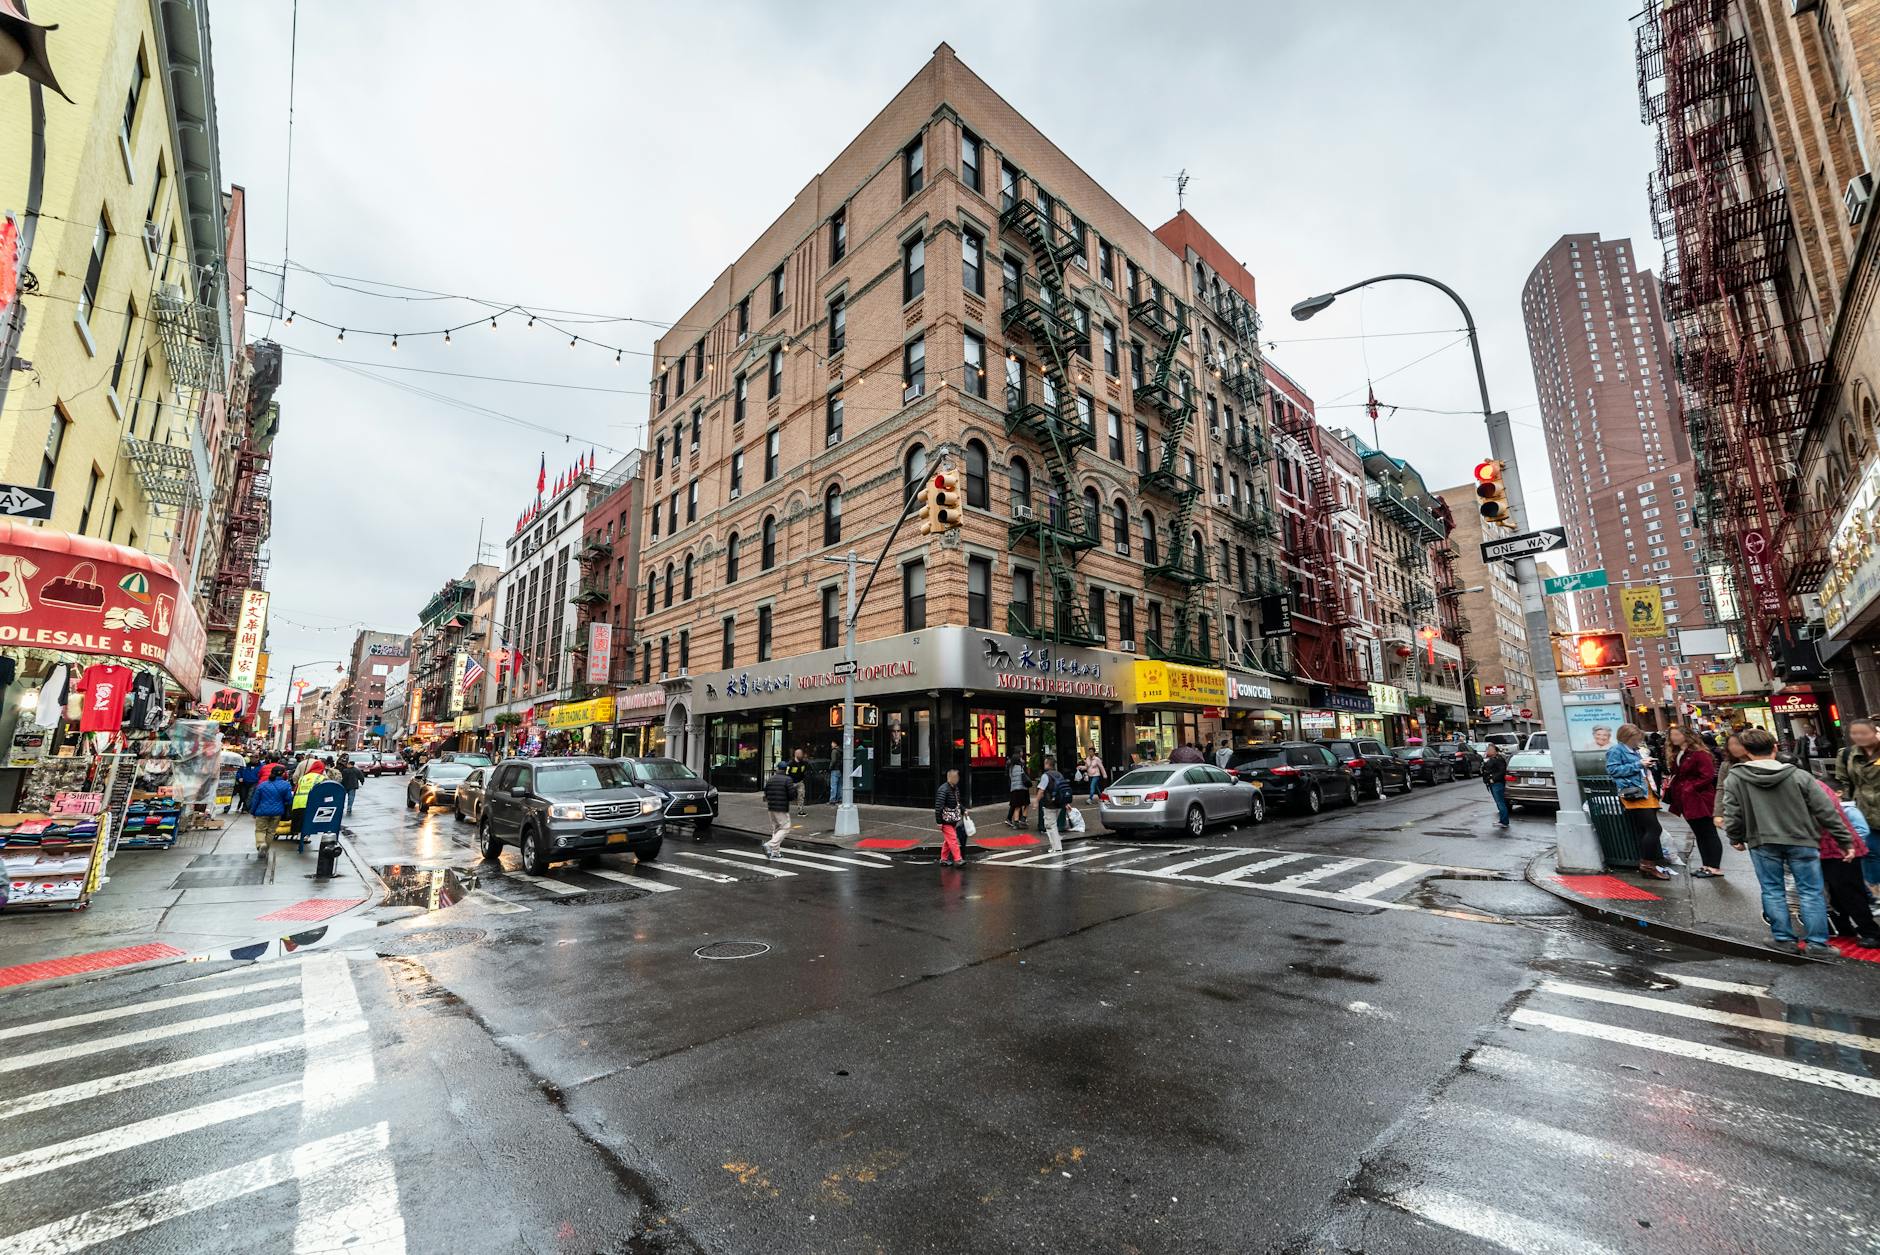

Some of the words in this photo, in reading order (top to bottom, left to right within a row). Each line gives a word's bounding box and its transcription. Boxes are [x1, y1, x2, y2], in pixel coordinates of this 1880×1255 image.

[1492, 543, 1516, 555] ONE
[1526, 536, 1552, 548] WAY
[1553, 574, 1582, 588] MOTT
[122, 639, 134, 653] &
[913, 637, 920, 645] 52
[798, 674, 824, 689] MOTT
[865, 660, 917, 680] OPTICAL
[997, 673, 1032, 690] MOTT
[1033, 677, 1075, 695] STREET
[1076, 681, 1118, 698] OPTICAL
[1577, 693, 1605, 701] TITAN
